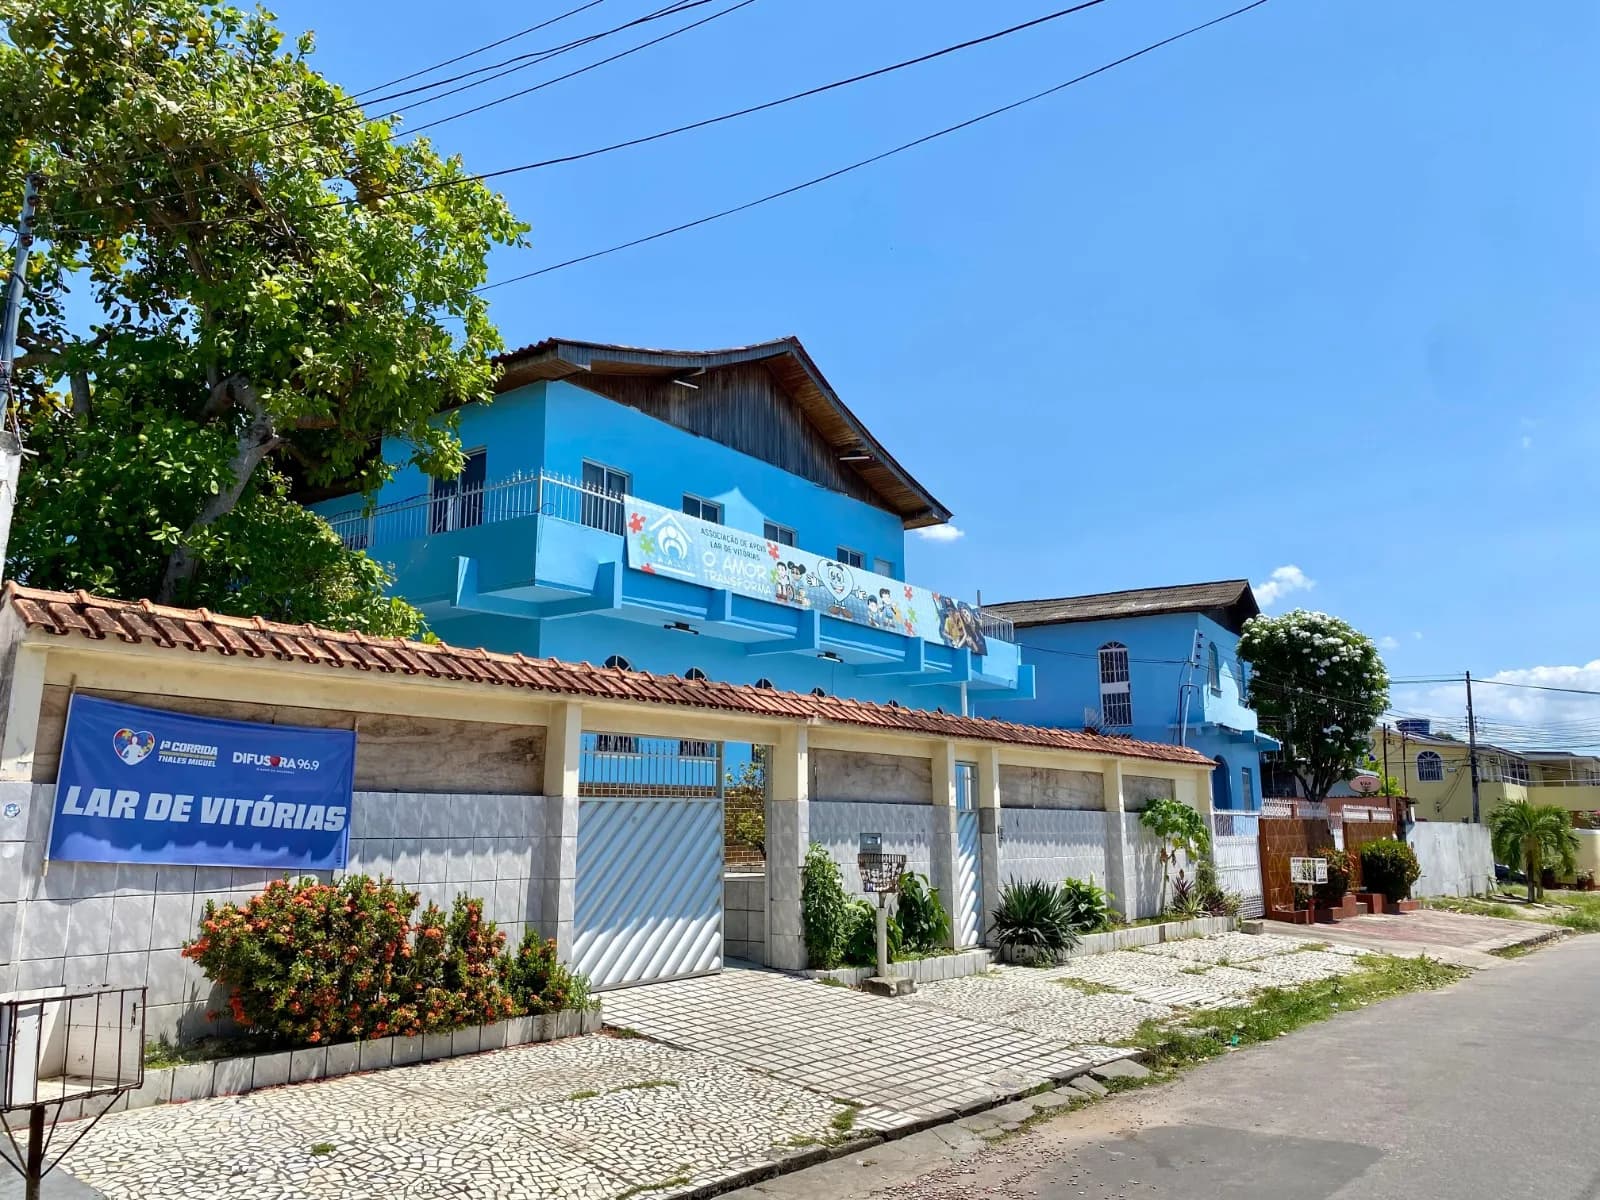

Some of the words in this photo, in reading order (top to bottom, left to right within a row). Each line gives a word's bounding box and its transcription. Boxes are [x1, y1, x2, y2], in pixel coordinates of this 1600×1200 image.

[701, 527, 739, 545] ASSOCIAÇÃO
[710, 541, 722, 551] LAR
[723, 544, 732, 553] DE
[702, 551, 716, 567] O
[723, 556, 768, 581] AMOR
[703, 568, 773, 595] TRANSFORMA
[171, 741, 218, 756] CORRIDA
[158, 755, 187, 765] THALES
[187, 757, 217, 768] MIGUEL
[297, 758, 320, 771] 96.9
[62, 785, 140, 819] LAR
[144, 792, 194, 823] DE
[200, 794, 347, 832] VITÓRIAS
